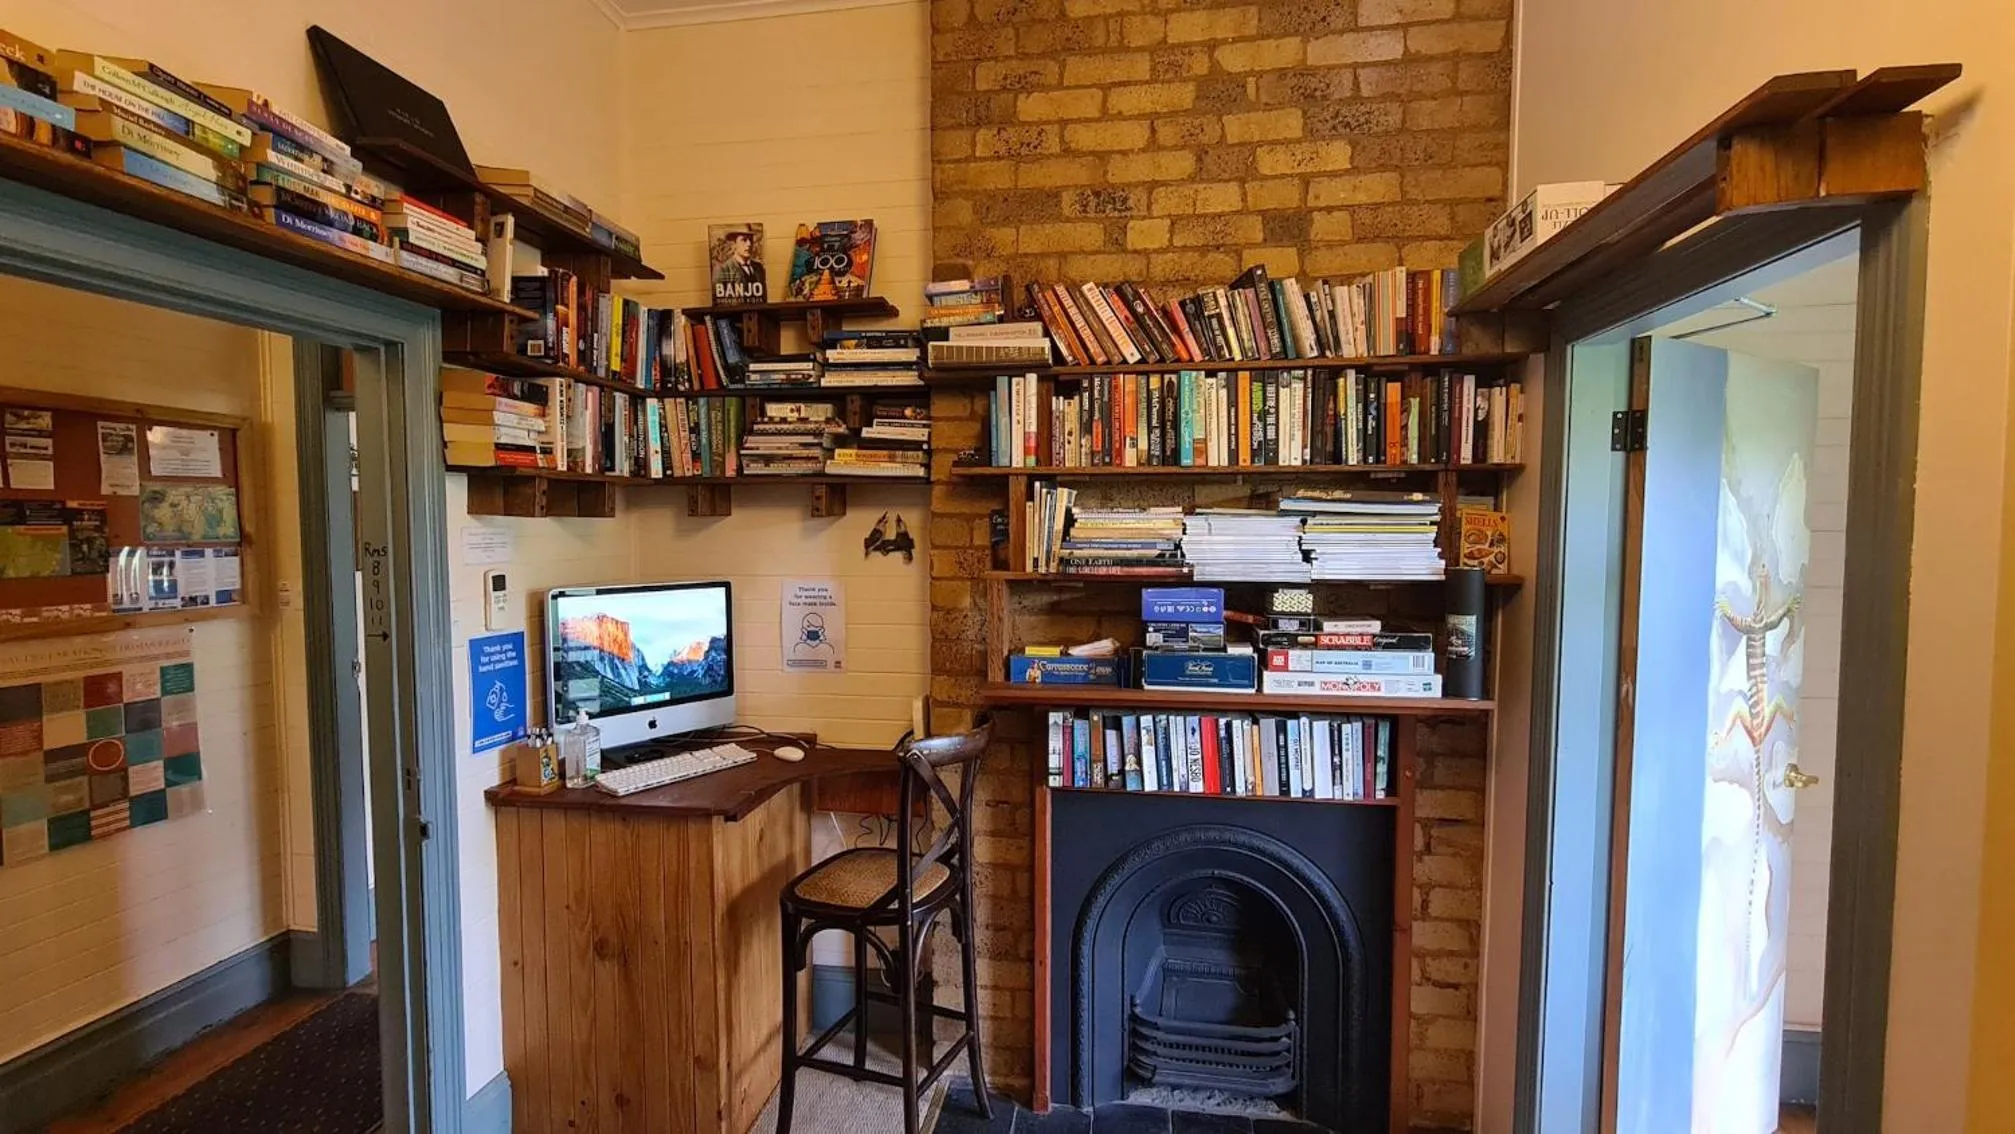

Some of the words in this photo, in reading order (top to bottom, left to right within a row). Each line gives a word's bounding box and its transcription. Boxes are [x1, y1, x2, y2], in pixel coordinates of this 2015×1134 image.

[281, 213, 294, 226] Di
[814, 254, 848, 270] 100
[715, 281, 763, 298] BANJO
[1464, 516, 1499, 528] SHELLS
[363, 542, 388, 557] Rms
[372, 560, 381, 577] 8
[1088, 558, 1113, 566] EARTH
[372, 579, 381, 595] 9
[369, 597, 385, 612] 10
[1320, 634, 1372, 646] SCRABBLE
[483, 644, 501, 654] Thank
[502, 642, 514, 652] you
[480, 655, 490, 664] for
[490, 653, 506, 663] using
[506, 650, 517, 659] the
[1188, 745, 1201, 757] JO
